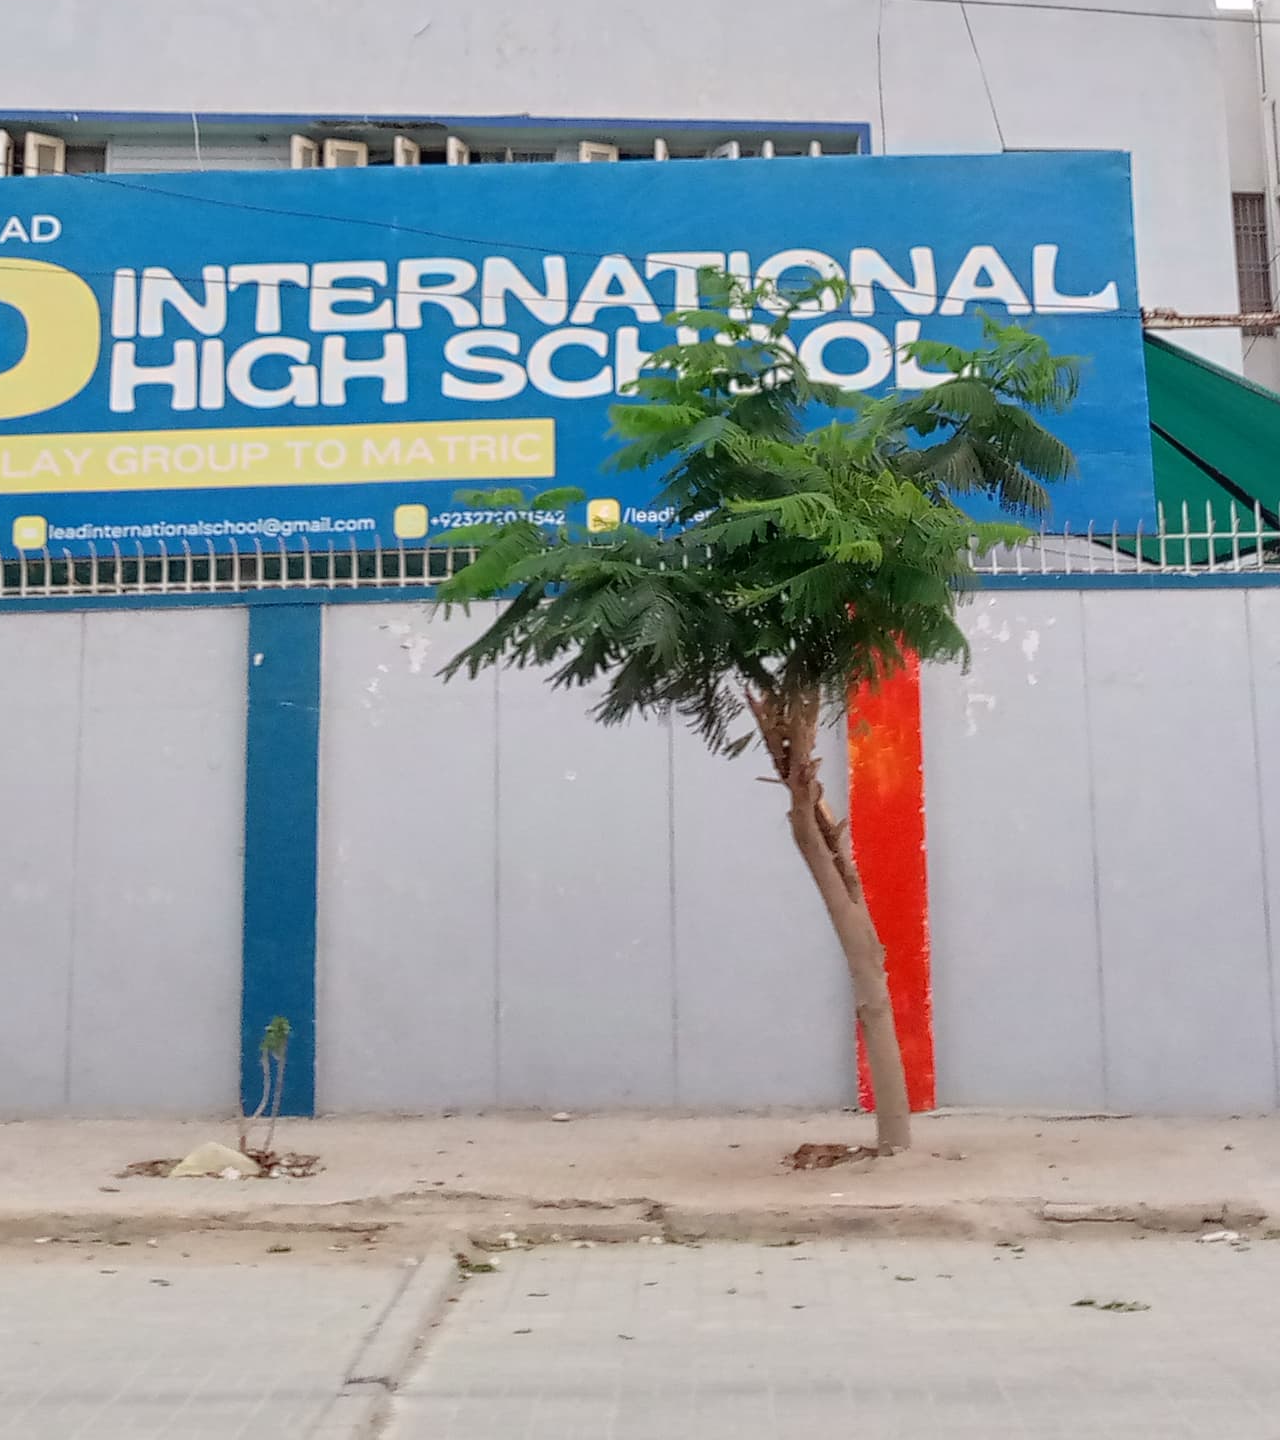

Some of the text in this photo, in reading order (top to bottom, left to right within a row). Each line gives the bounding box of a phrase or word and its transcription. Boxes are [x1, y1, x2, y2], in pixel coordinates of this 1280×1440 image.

[111, 244, 1120, 339] INTERNATIONAL
[109, 332, 409, 413] HIGH
[107, 441, 269, 477] GROUP
[286, 438, 347, 470] TO
[362, 432, 544, 467] MATRIC
[48, 516, 376, 541] leadinternationalschool@gmail.com
